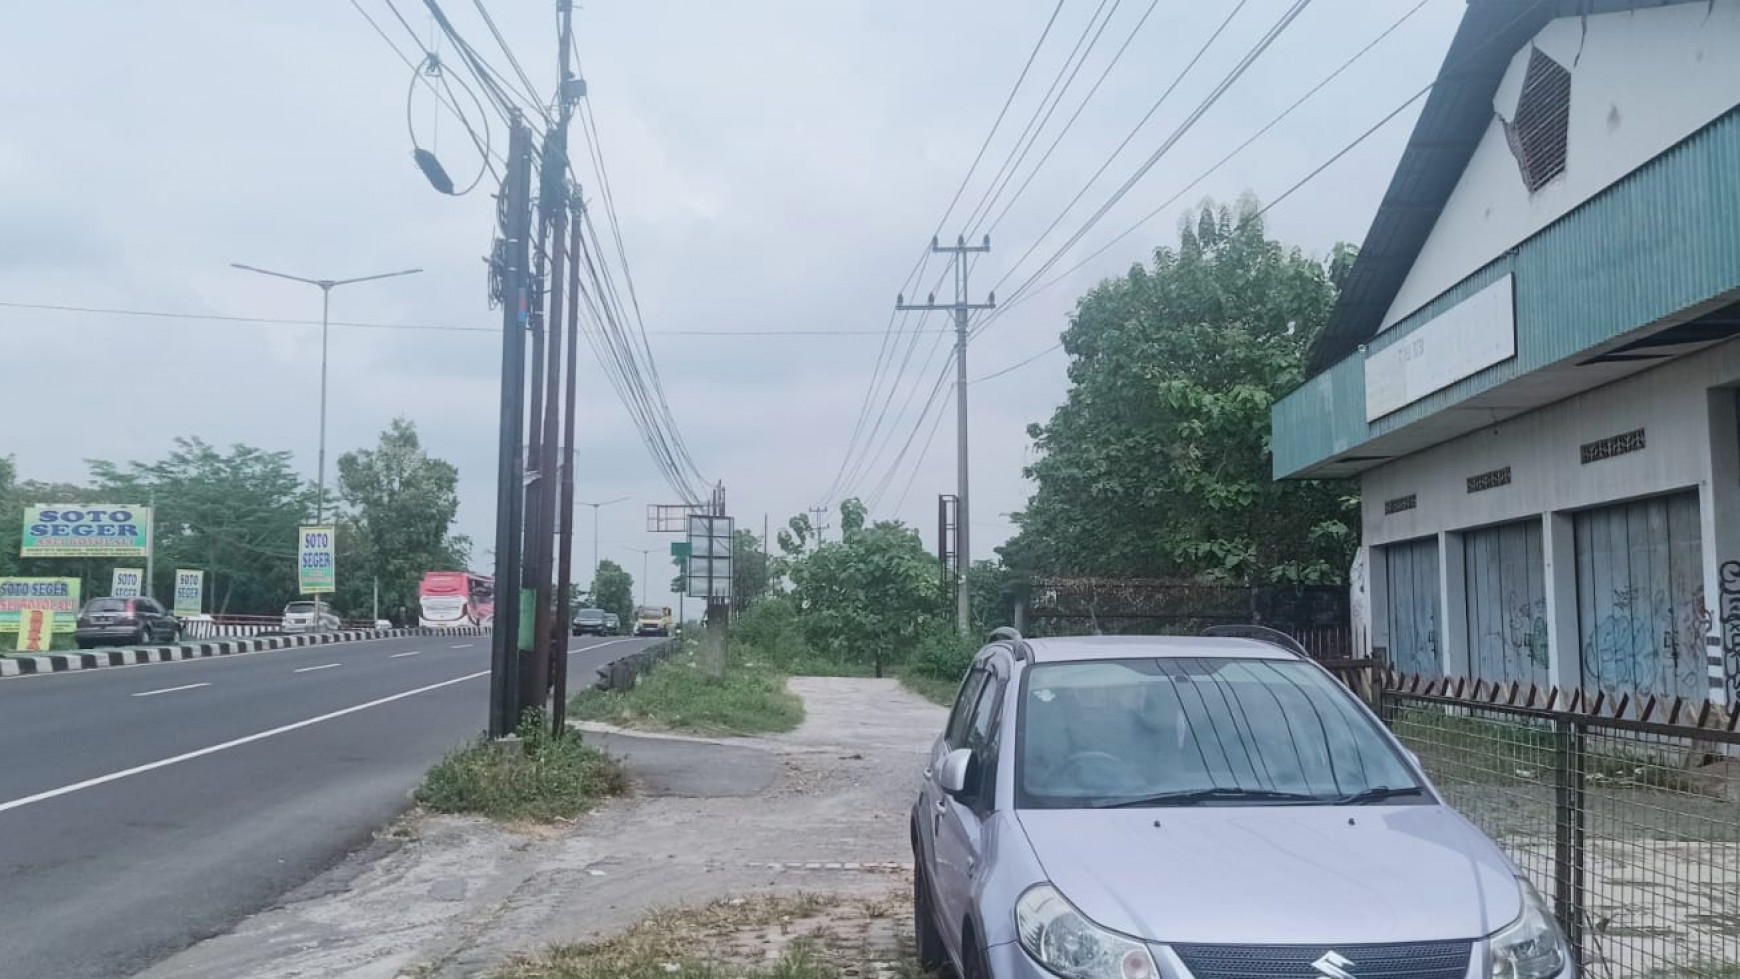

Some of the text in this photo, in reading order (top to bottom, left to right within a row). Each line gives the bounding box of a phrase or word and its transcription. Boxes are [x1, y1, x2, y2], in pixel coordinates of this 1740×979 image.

[40, 510, 133, 523] SOTO
[30, 524, 138, 537] SEGER
[305, 533, 328, 548] SOTO
[303, 552, 330, 568] SEGER
[117, 573, 138, 586] SOTO
[180, 574, 199, 586] SOTO
[0, 583, 69, 597] SOTO SEGER
[178, 587, 199, 598] SEGER
